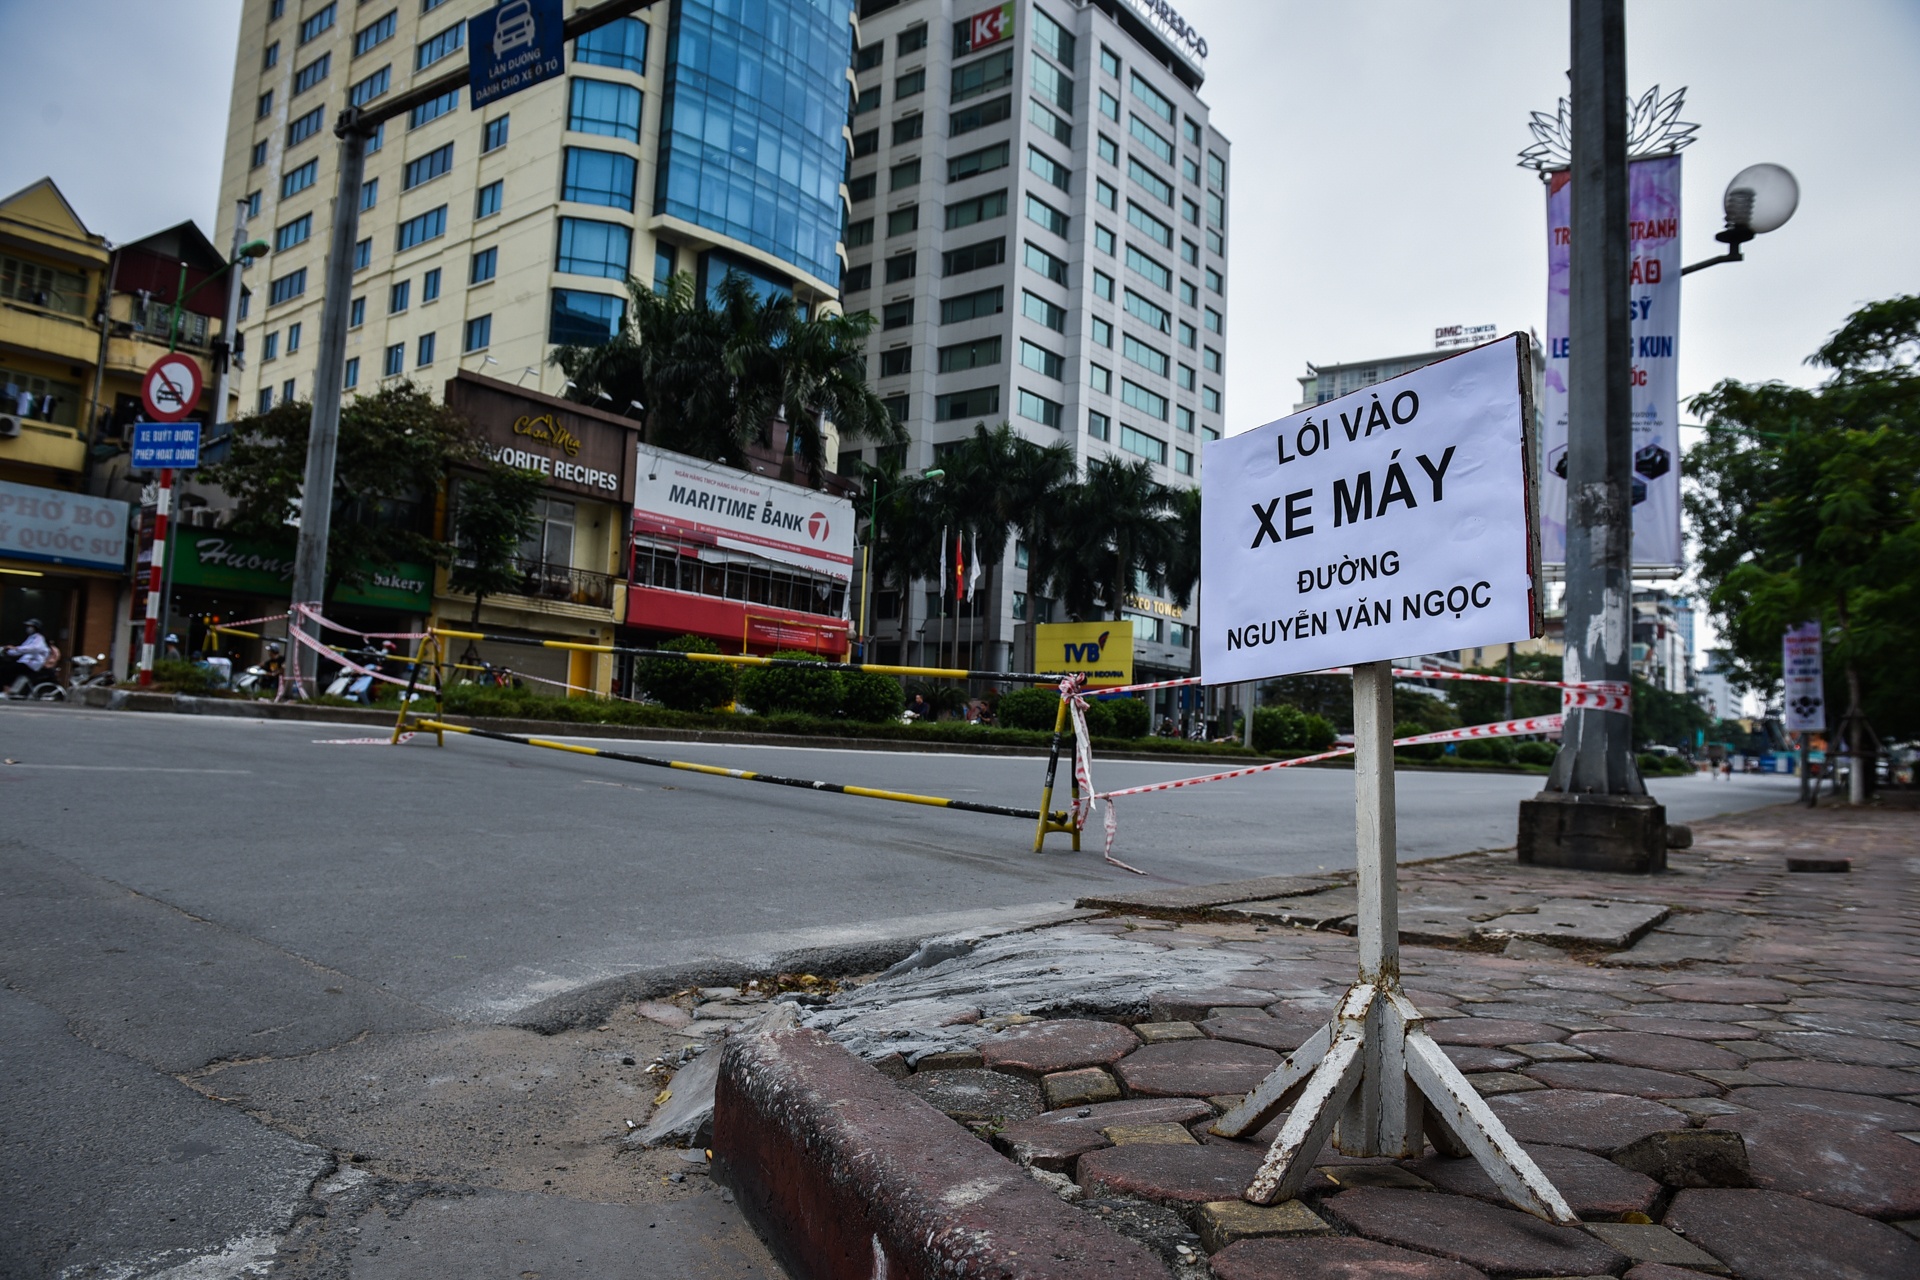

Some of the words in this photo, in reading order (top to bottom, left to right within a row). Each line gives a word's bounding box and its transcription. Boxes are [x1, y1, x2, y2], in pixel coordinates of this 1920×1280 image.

[488, 60, 507, 79] LÀN
[501, 75, 520, 91] CHO
[522, 68, 533, 82] XE
[535, 63, 543, 76] Ô
[545, 57, 558, 72] TÔ
[1629, 218, 1677, 240] TRANH
[1630, 255, 1661, 286] ÁO
[1435, 324, 1462, 339] DMC
[1464, 323, 1496, 335] TOWER
[1639, 336, 1673, 358] KUN
[141, 430, 151, 442] XE
[513, 415, 550, 439] Casa
[553, 425, 582, 457] Mia
[1277, 416, 1330, 465] LỐI
[1340, 390, 1419, 442] VÀO
[135, 447, 155, 460] PHÉP
[479, 441, 551, 475] AVORITE
[554, 459, 617, 491] RECIPES
[0, 493, 66, 521] PHỞ
[73, 504, 116, 529] BÒ
[669, 484, 757, 521] MARITIME
[761, 507, 804, 533] BANK
[1250, 488, 1314, 549] XE
[1332, 445, 1457, 528] MÁY
[18, 526, 85, 552] QUỐC
[90, 538, 122, 557] SƯ
[373, 572, 425, 593] bakery
[1297, 550, 1400, 594] ĐƯỜNG
[1153, 600, 1183, 619] TOWER
[1227, 608, 1327, 651] NGUYỄN
[1335, 597, 1392, 631] VĂN
[1402, 581, 1491, 621] NGỌC
[1064, 643, 1100, 663] IVB
